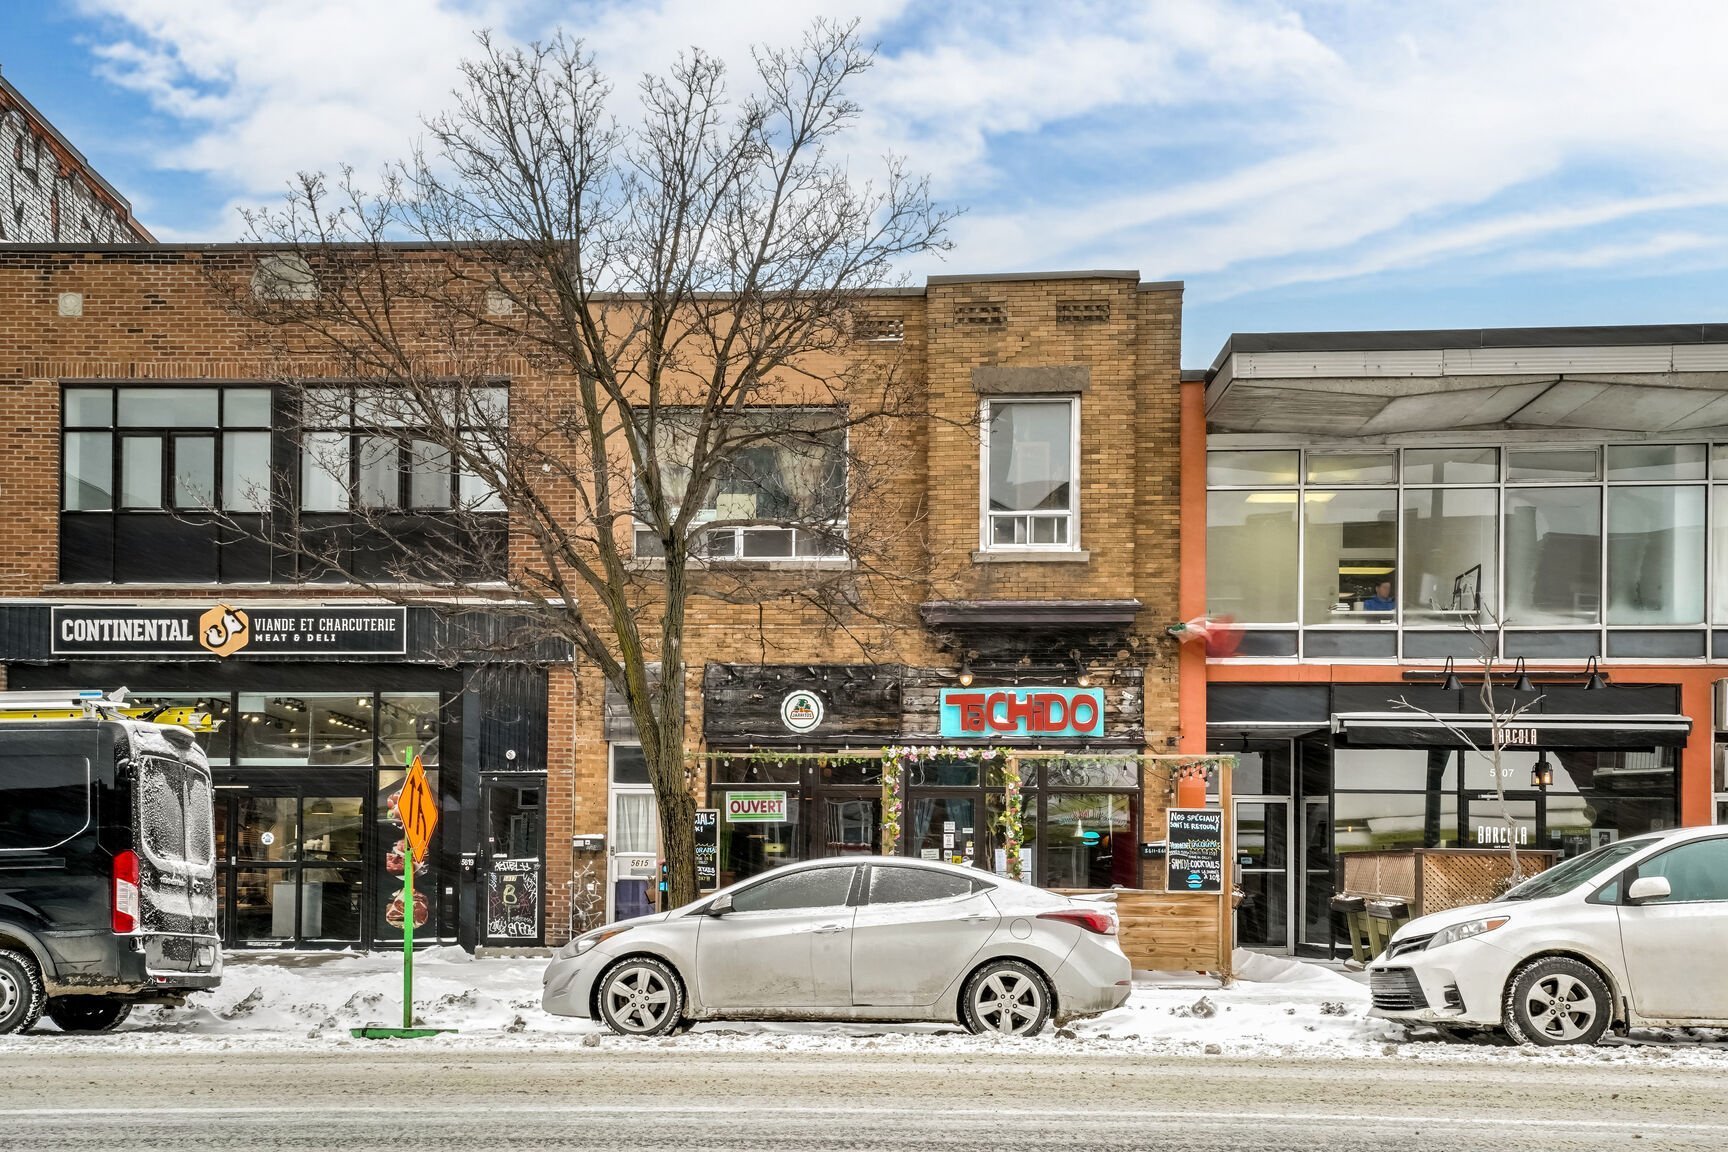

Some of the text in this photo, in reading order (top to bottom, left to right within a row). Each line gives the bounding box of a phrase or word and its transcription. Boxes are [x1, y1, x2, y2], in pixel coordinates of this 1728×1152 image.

[254, 618, 396, 632] VIANDE ET CHARCUTERIE
[61, 619, 193, 642] CONTINENTAL
[255, 633, 336, 642] MEAT & DELI
[1489, 769, 1514, 777] 507
[730, 801, 783, 813] OUVERT
[631, 859, 649, 867] 5615
